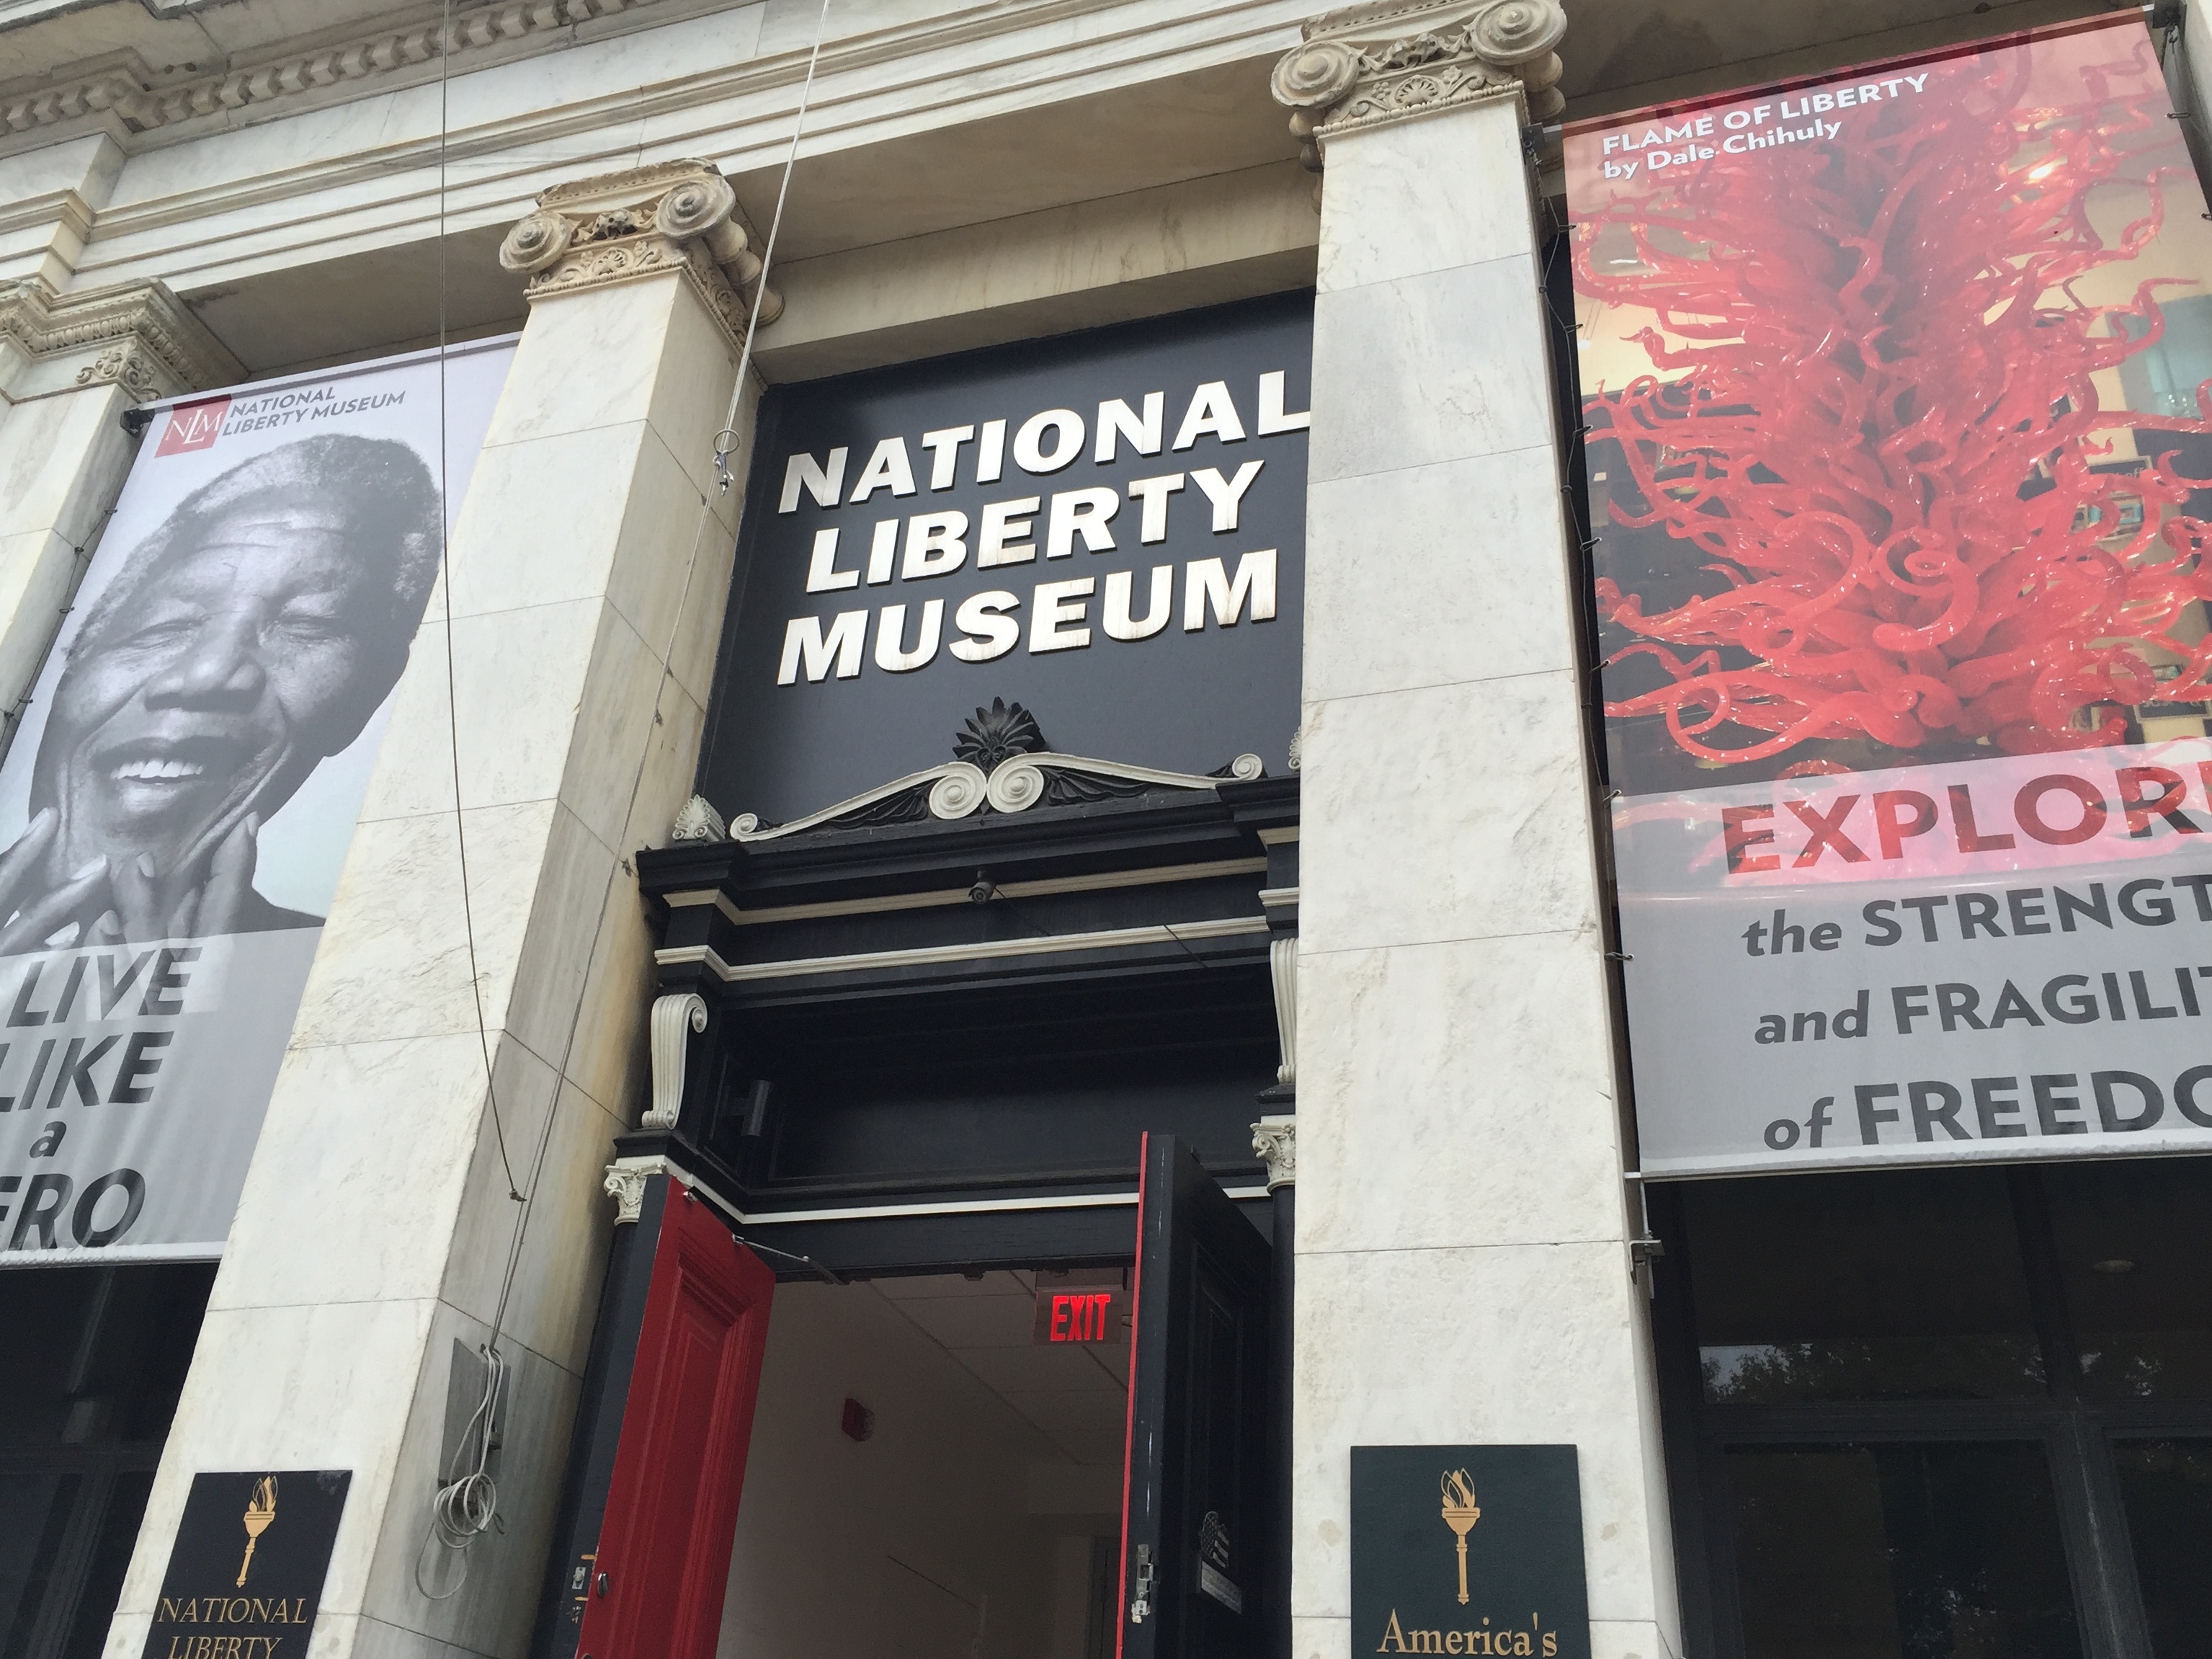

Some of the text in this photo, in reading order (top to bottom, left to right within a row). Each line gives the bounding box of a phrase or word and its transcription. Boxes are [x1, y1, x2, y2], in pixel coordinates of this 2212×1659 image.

[1602, 73, 1929, 155] FLAME OF LIBERTY
[1603, 118, 1842, 180] by Dale Chihuly
[164, 409, 224, 445] NLM
[222, 391, 406, 437] LIBERTY MUSEUM
[230, 386, 336, 418] NATIONAL
[777, 370, 1311, 515] NATIONAL
[806, 460, 1265, 593] LIBERTY
[777, 548, 1277, 686] MUSEUM
[1721, 761, 2212, 874] EXPLOR
[1741, 909, 1842, 956] the
[6, 946, 202, 1028] LIVE
[1754, 966, 2212, 1045] and FRAGILI
[30, 1121, 67, 1159] a
[1763, 1095, 1834, 1151] of
[1050, 1294, 1111, 1341] EXIT
[156, 1598, 308, 1624] NATIONAL
[1376, 1608, 1558, 1658] America's
[168, 1636, 283, 1659] LIBERTY
